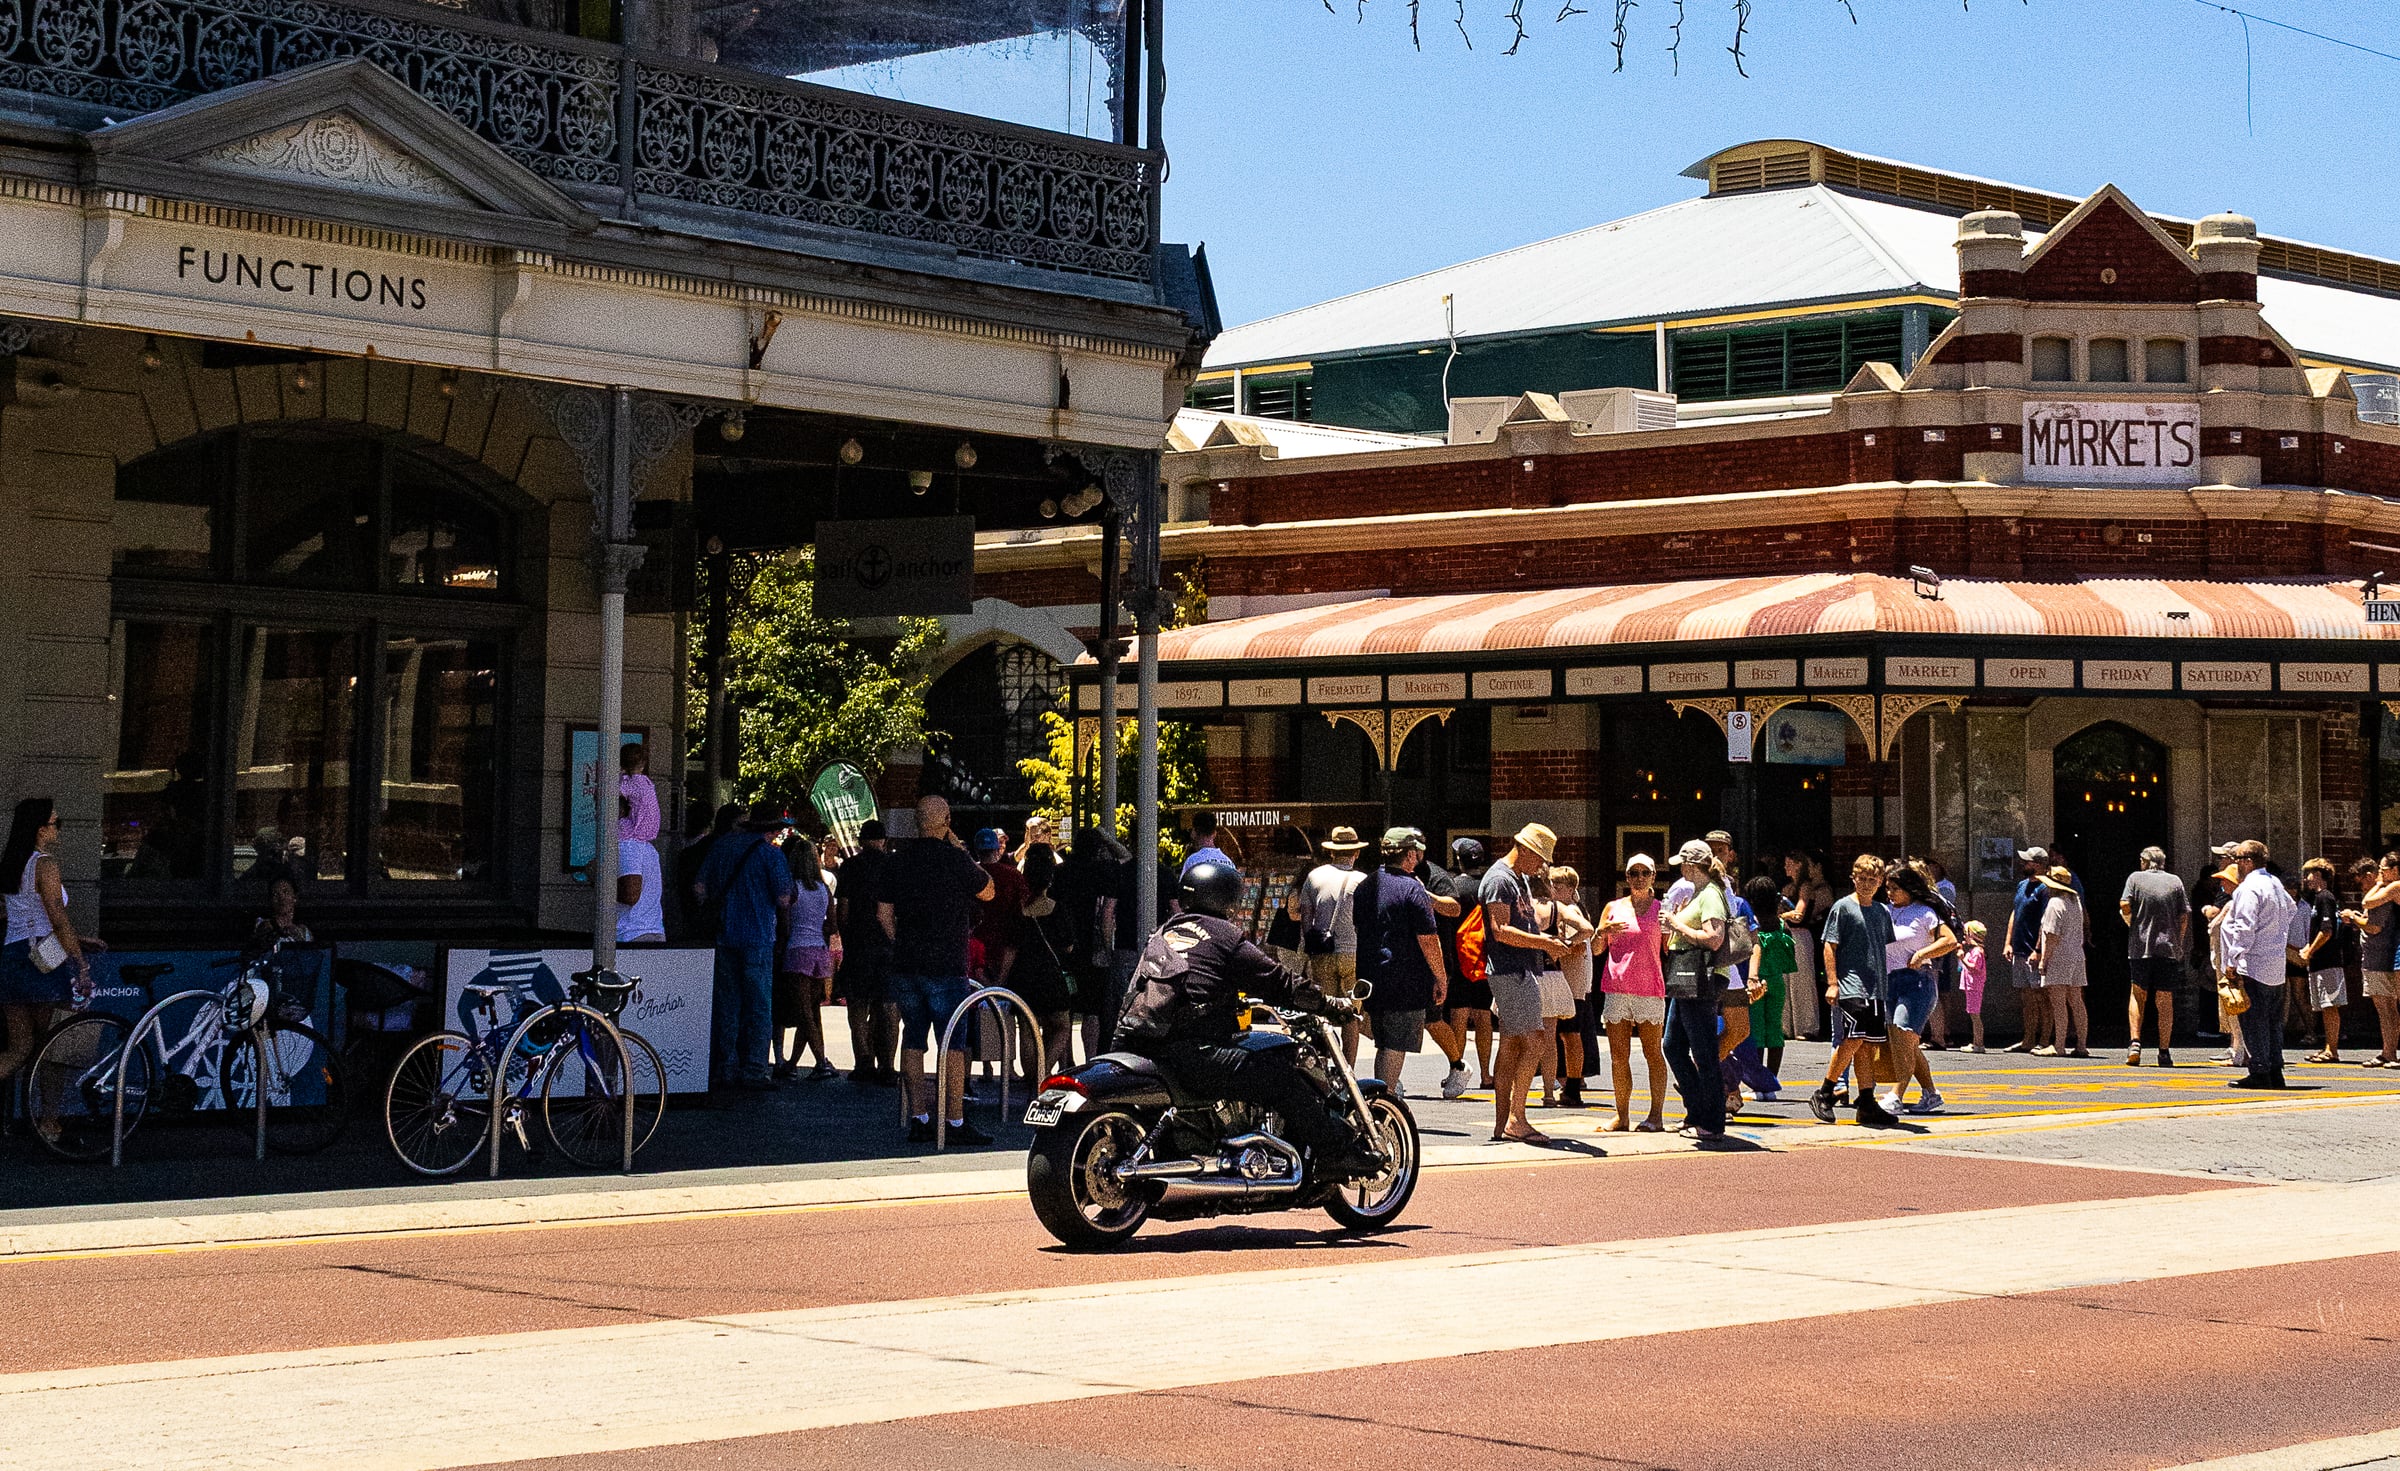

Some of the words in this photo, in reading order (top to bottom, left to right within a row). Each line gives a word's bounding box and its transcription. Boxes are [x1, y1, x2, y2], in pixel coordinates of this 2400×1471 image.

[178, 245, 428, 310] FUNCTIONS
[2028, 417, 2195, 468] MARKETS
[895, 555, 963, 579] anchor
[1318, 683, 1371, 697] FREMANTLE
[1404, 681, 1450, 694] MARKETS
[1489, 678, 1535, 691] CONTINUE
[1581, 677, 1593, 687] TO
[1613, 675, 1626, 685] BE
[1751, 668, 1779, 680] BEST
[1812, 666, 1859, 680] MARKET
[1898, 663, 1960, 678] MARKET
[2009, 665, 2047, 679] OPEN
[2100, 666, 2153, 682] FRIDAY
[2187, 668, 2263, 683] SATURDAY
[2296, 669, 2353, 684] SUNDAY
[96, 986, 141, 998] ANCHOR
[637, 993, 687, 1020] Anchor
